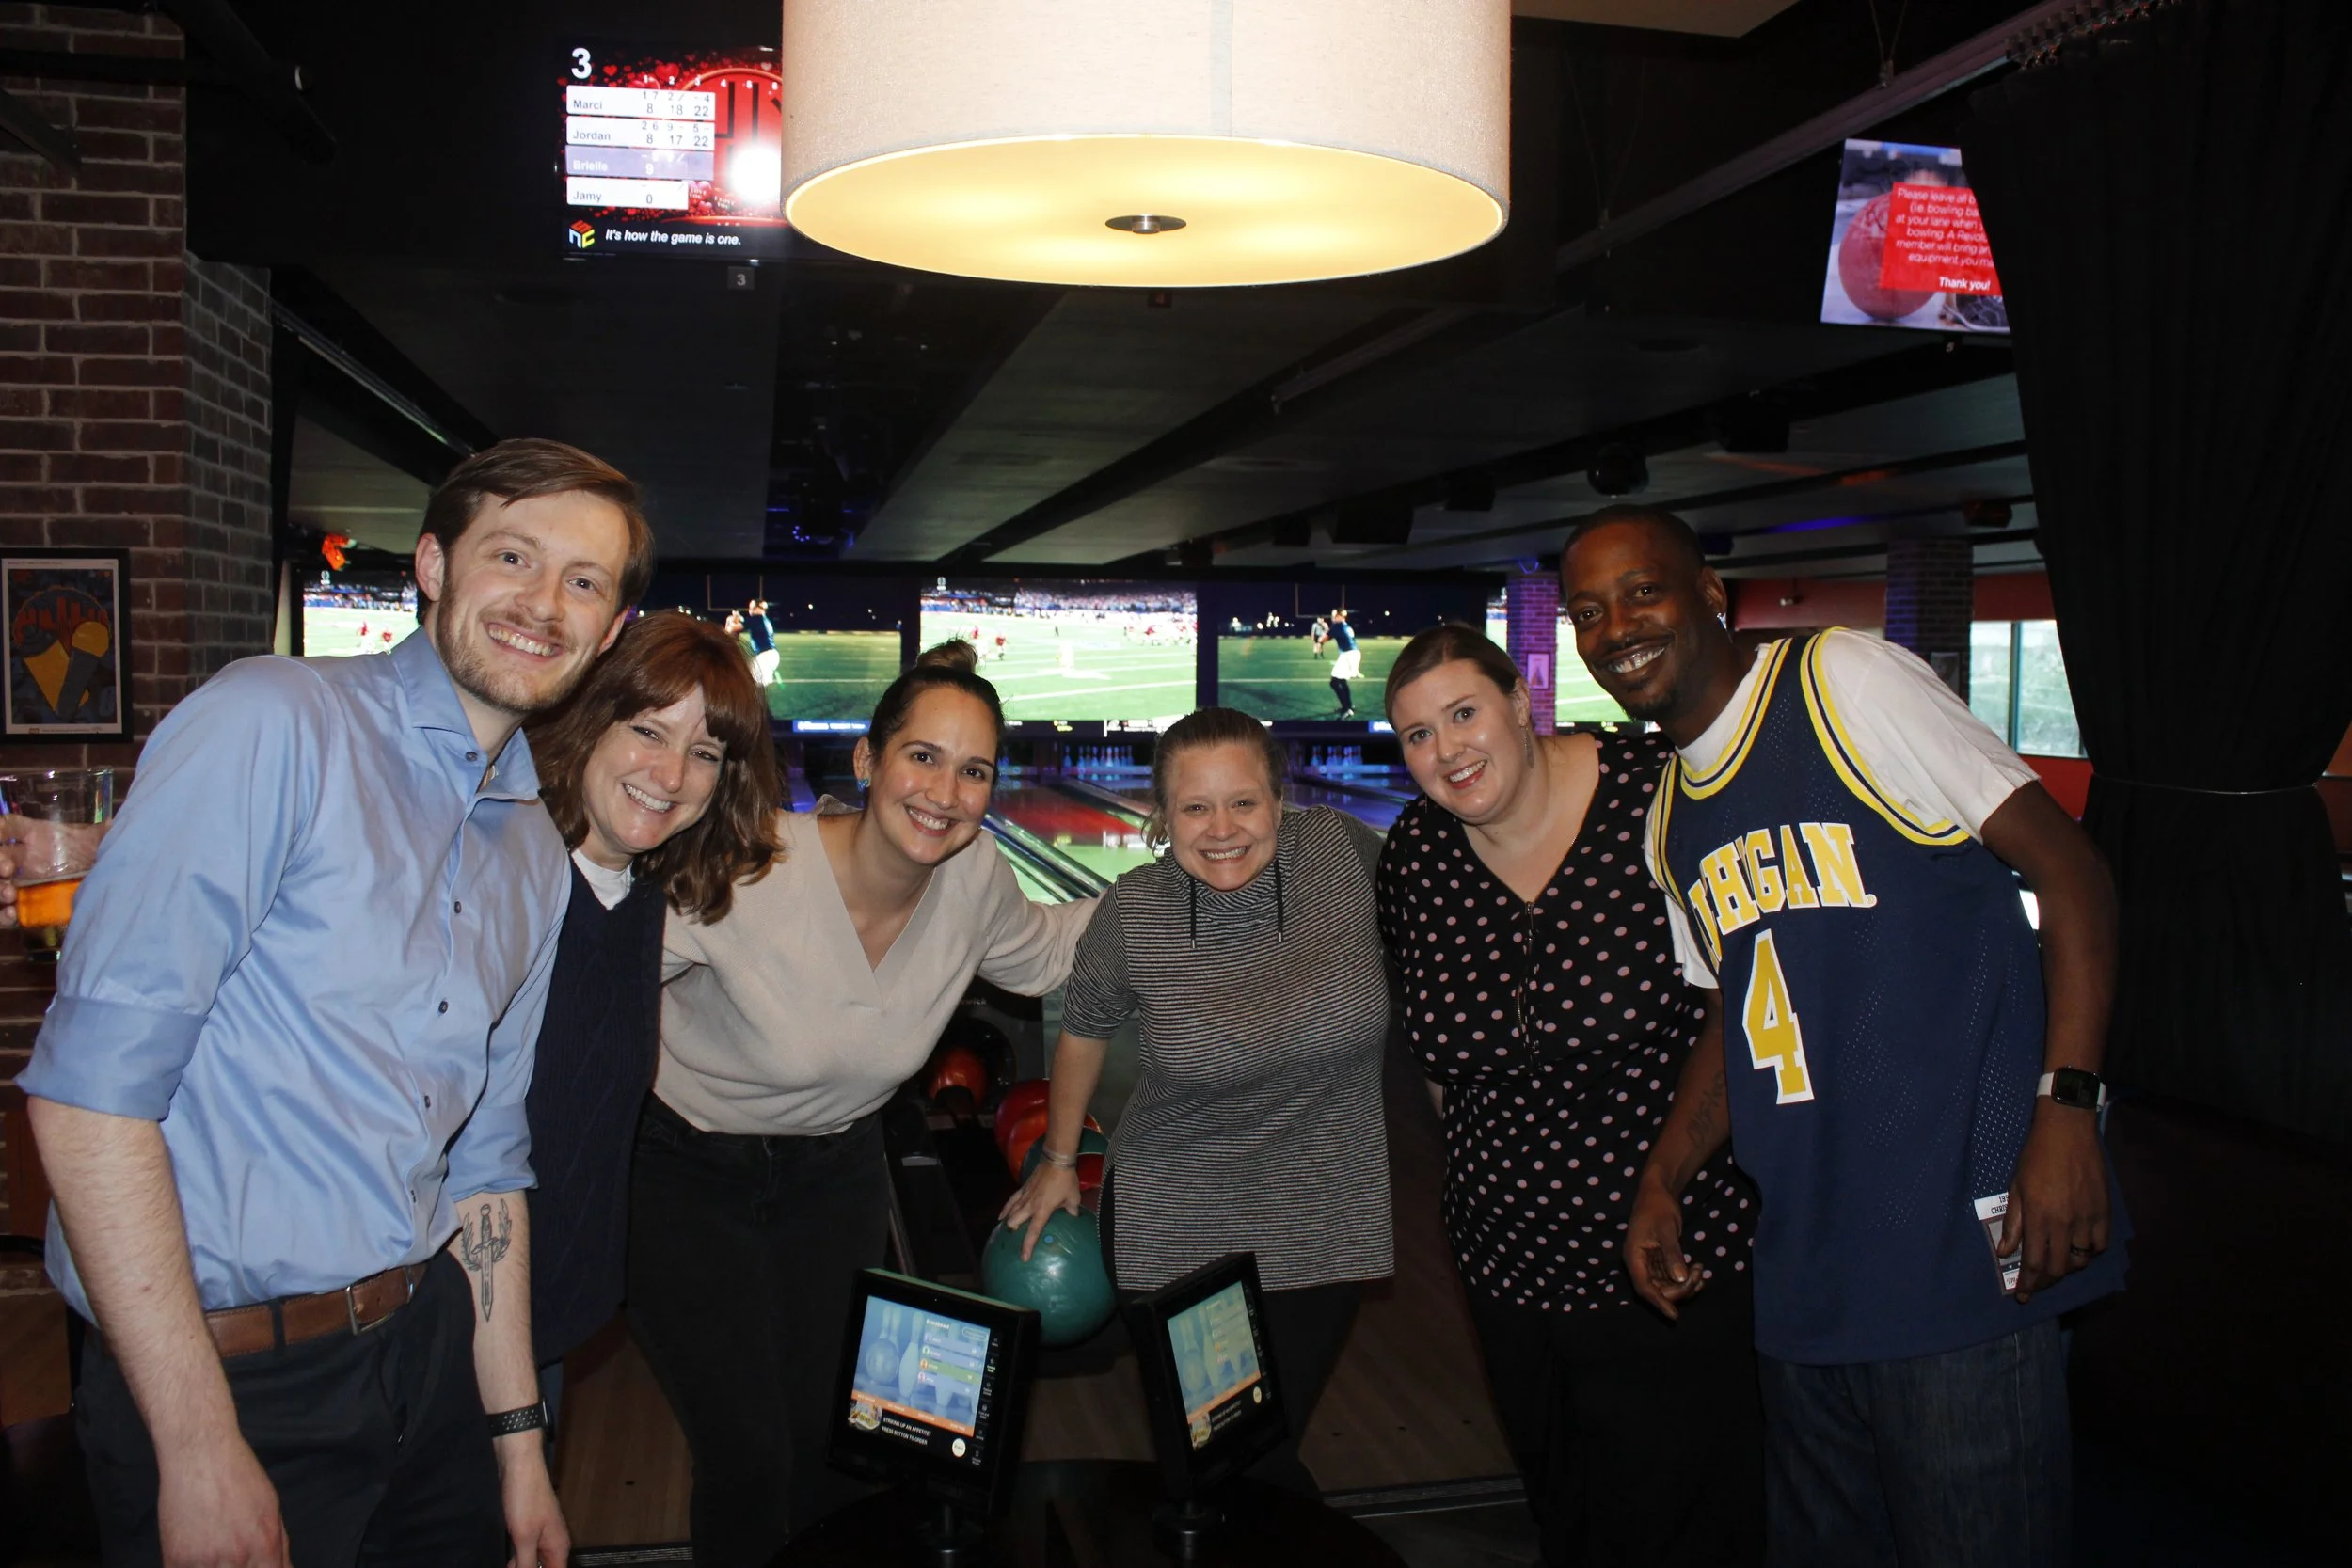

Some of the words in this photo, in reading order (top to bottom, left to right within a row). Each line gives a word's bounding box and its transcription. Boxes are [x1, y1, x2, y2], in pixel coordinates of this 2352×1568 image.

[571, 47, 592, 79] 3
[720, 79, 727, 87] 4
[573, 99, 603, 110] Marci
[647, 103, 653, 114] 8
[671, 105, 683, 115] 18
[694, 106, 709, 116] 22
[573, 130, 611, 141] Jordan
[646, 134, 653, 144] 8
[670, 135, 683, 145] 17
[694, 136, 708, 146] 22
[573, 160, 608, 172] Brielle
[573, 191, 602, 203] Jamy
[646, 194, 653, 204] 0
[1898, 188, 1928, 200] Please
[1930, 191, 1955, 203] leave
[1927, 204, 1964, 217] bowling
[1907, 215, 1929, 225] your
[1952, 219, 1977, 229] when
[605, 228, 622, 241] It's
[624, 229, 648, 241] how
[650, 230, 668, 242] the
[671, 233, 702, 245] game
[705, 233, 715, 244] is
[717, 236, 741, 245] one.
[1947, 230, 1954, 239] A
[1896, 240, 1935, 249] member
[1953, 244, 1977, 255] bring
[1908, 253, 1958, 265] equipment
[737, 273, 746, 286] 3
[1939, 276, 1967, 288] Thank
[1969, 280, 1990, 291] you!
[1742, 928, 1815, 1105] 4
